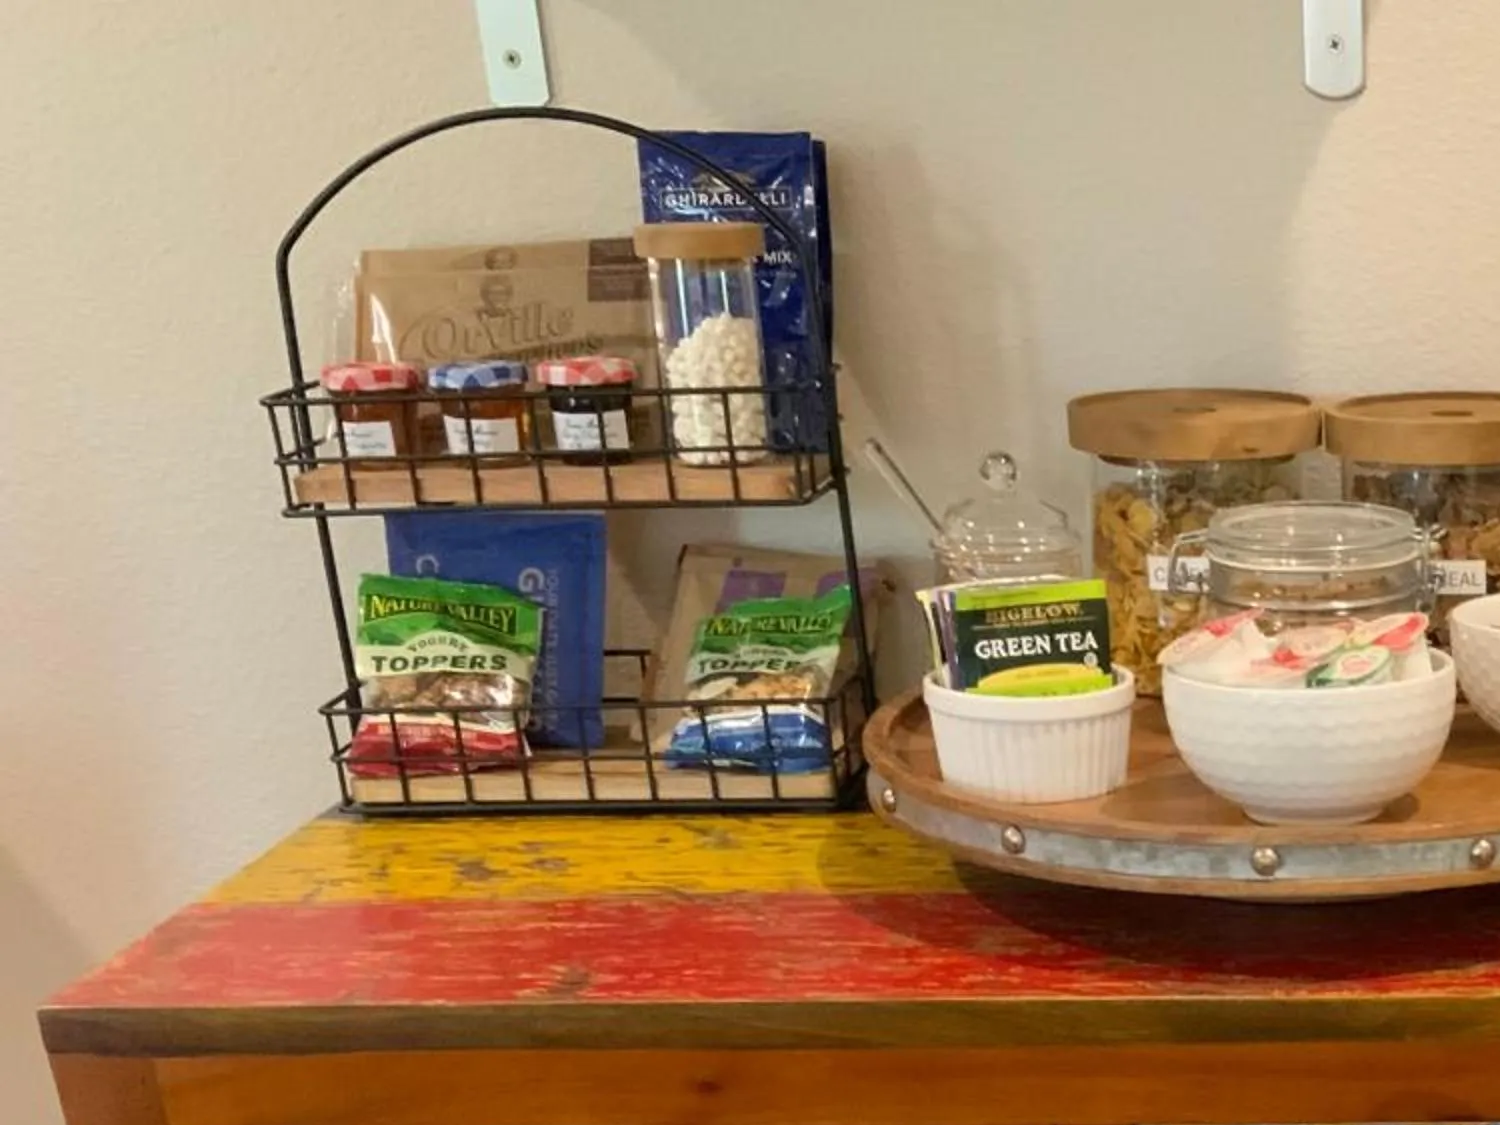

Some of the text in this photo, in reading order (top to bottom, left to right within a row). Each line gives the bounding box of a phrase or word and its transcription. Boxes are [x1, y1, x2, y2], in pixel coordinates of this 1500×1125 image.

[664, 191, 786, 209] GHIRARDLLI
[763, 250, 794, 265] MIX
[446, 601, 515, 634] VALLEY
[984, 602, 1081, 624] BIGELOW
[405, 633, 471, 653] YOGURT
[974, 630, 1098, 660] GREEN TEA
[371, 654, 508, 673] TOPPERS
